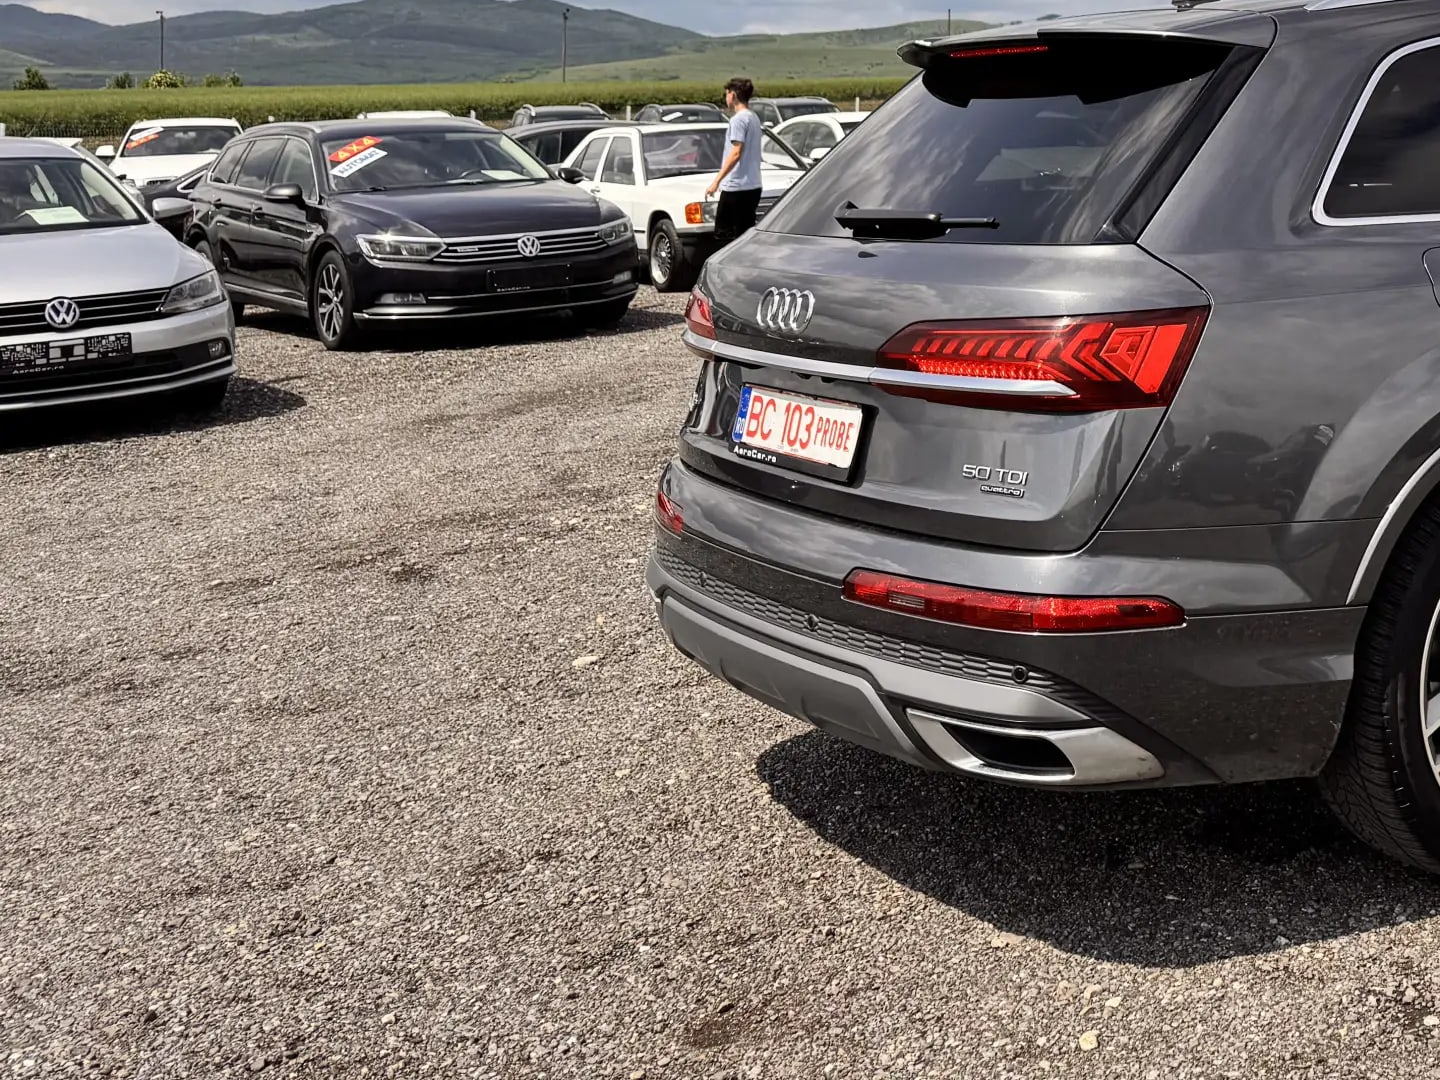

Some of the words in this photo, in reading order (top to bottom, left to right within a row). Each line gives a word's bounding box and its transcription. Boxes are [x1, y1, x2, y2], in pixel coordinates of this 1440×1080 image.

[46, 299, 78, 327] VW
[746, 395, 776, 440] BC
[781, 402, 815, 450] 103
[814, 416, 855, 452] PROBE
[733, 445, 777, 463] AeroCar.ro
[962, 464, 991, 481] 50
[995, 468, 1028, 486] TDI
[981, 485, 1021, 496] quattro
